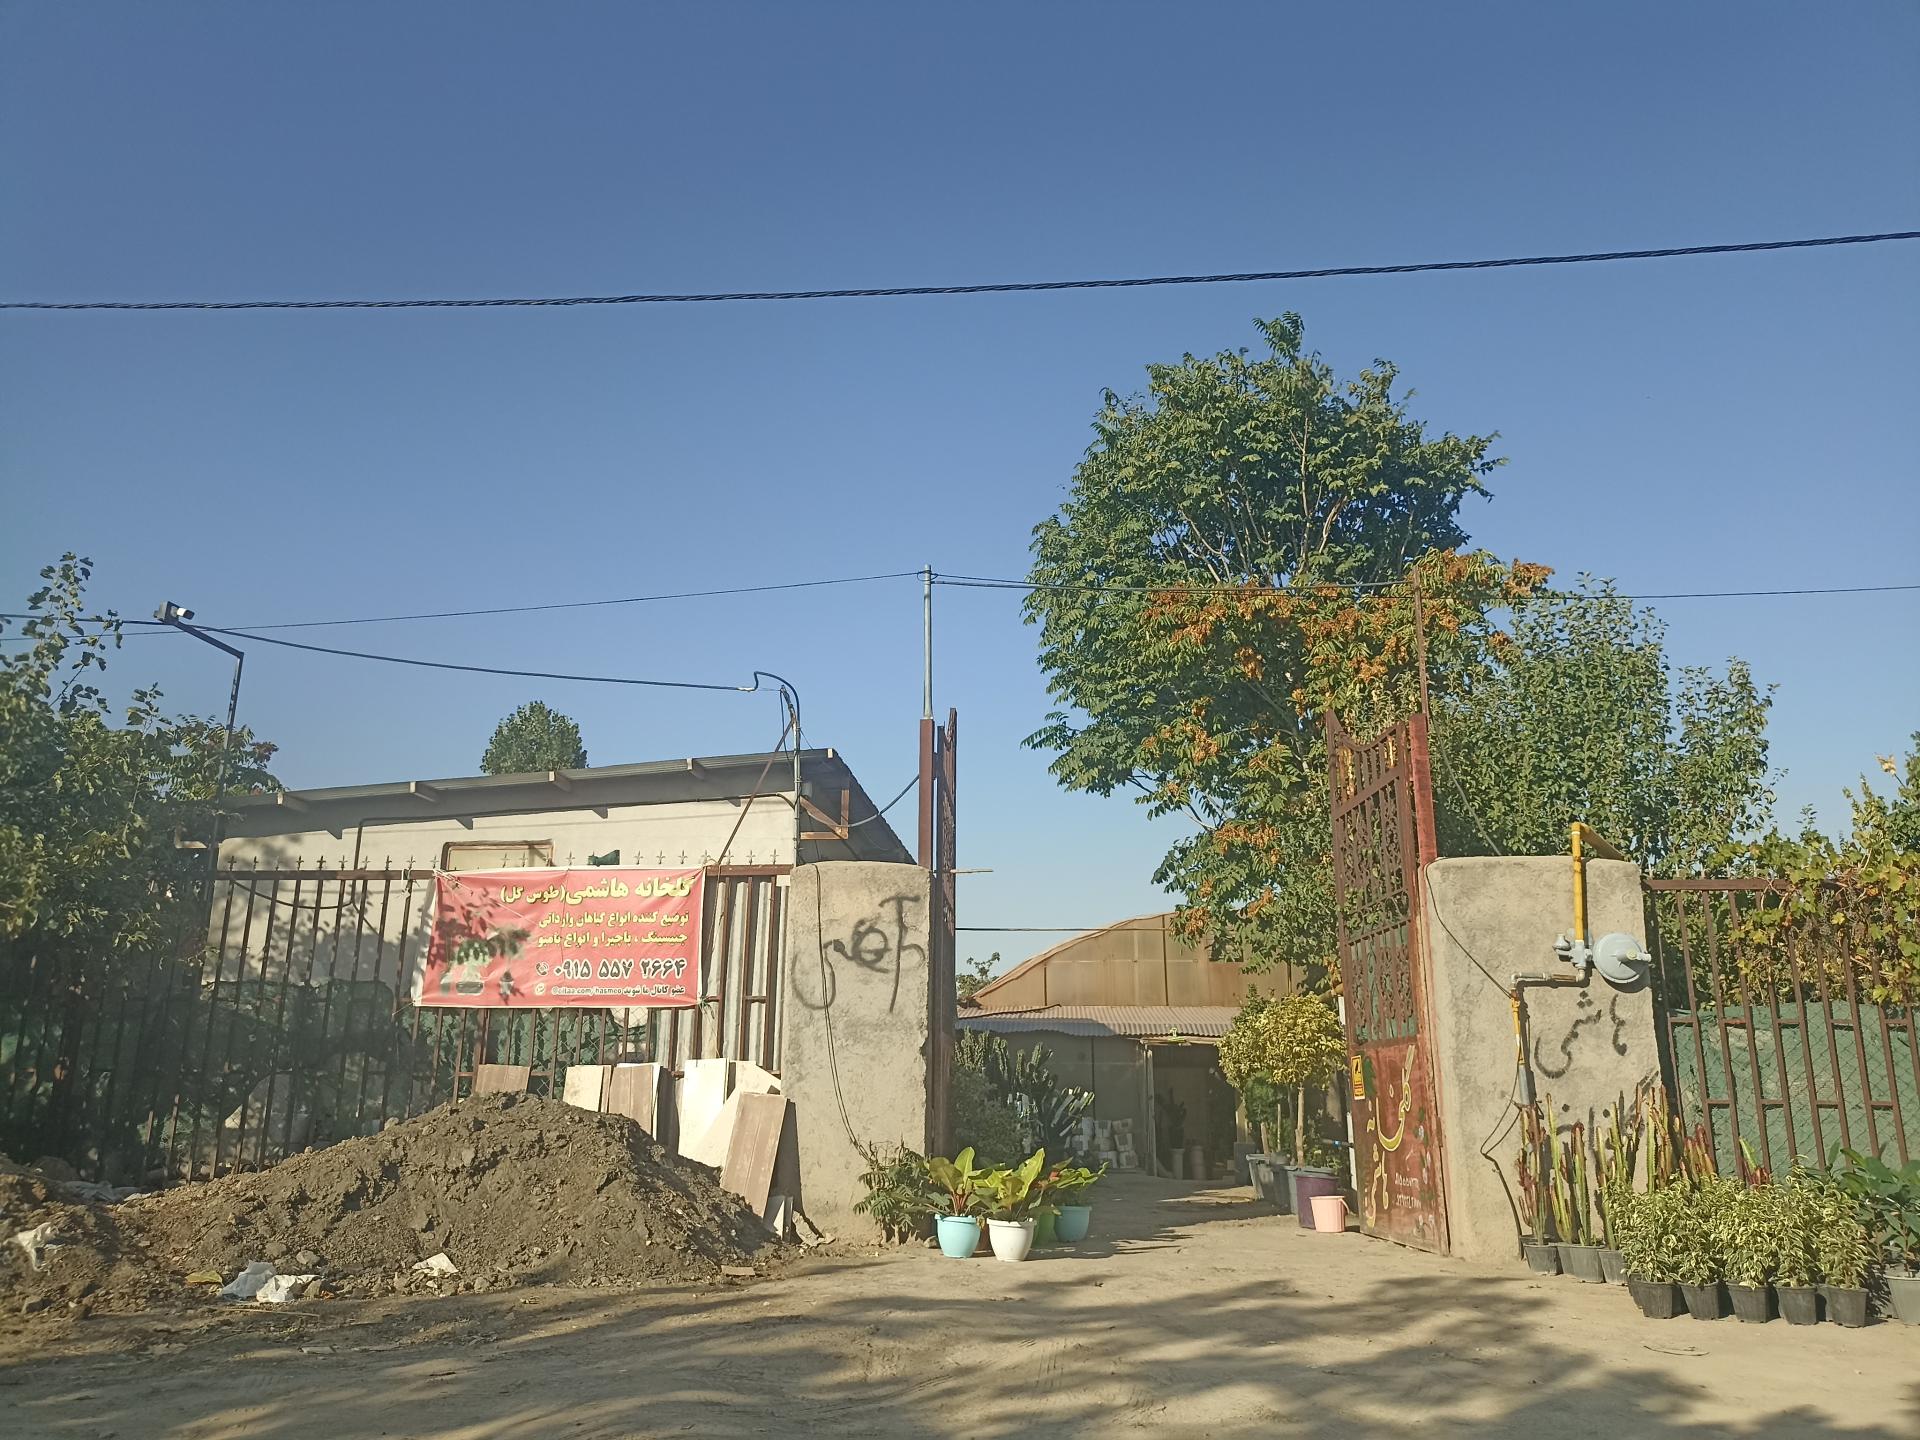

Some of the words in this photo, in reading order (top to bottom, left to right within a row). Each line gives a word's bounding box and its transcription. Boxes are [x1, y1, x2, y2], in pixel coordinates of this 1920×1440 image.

[635, 875, 695, 898] گلخانه
[538, 912, 573, 928] وارداتی
[576, 911, 606, 927] گیاهان
[608, 911, 631, 927] انواع
[633, 911, 658, 923] کننده
[563, 932, 590, 948] انواع
[554, 959, 591, 979] ۰۹۱۵
[599, 959, 632, 979] ۵۵۷
[641, 958, 686, 979] ۲۶۶۴
[641, 985, 650, 995] ما
[650, 985, 668, 997] کانال
